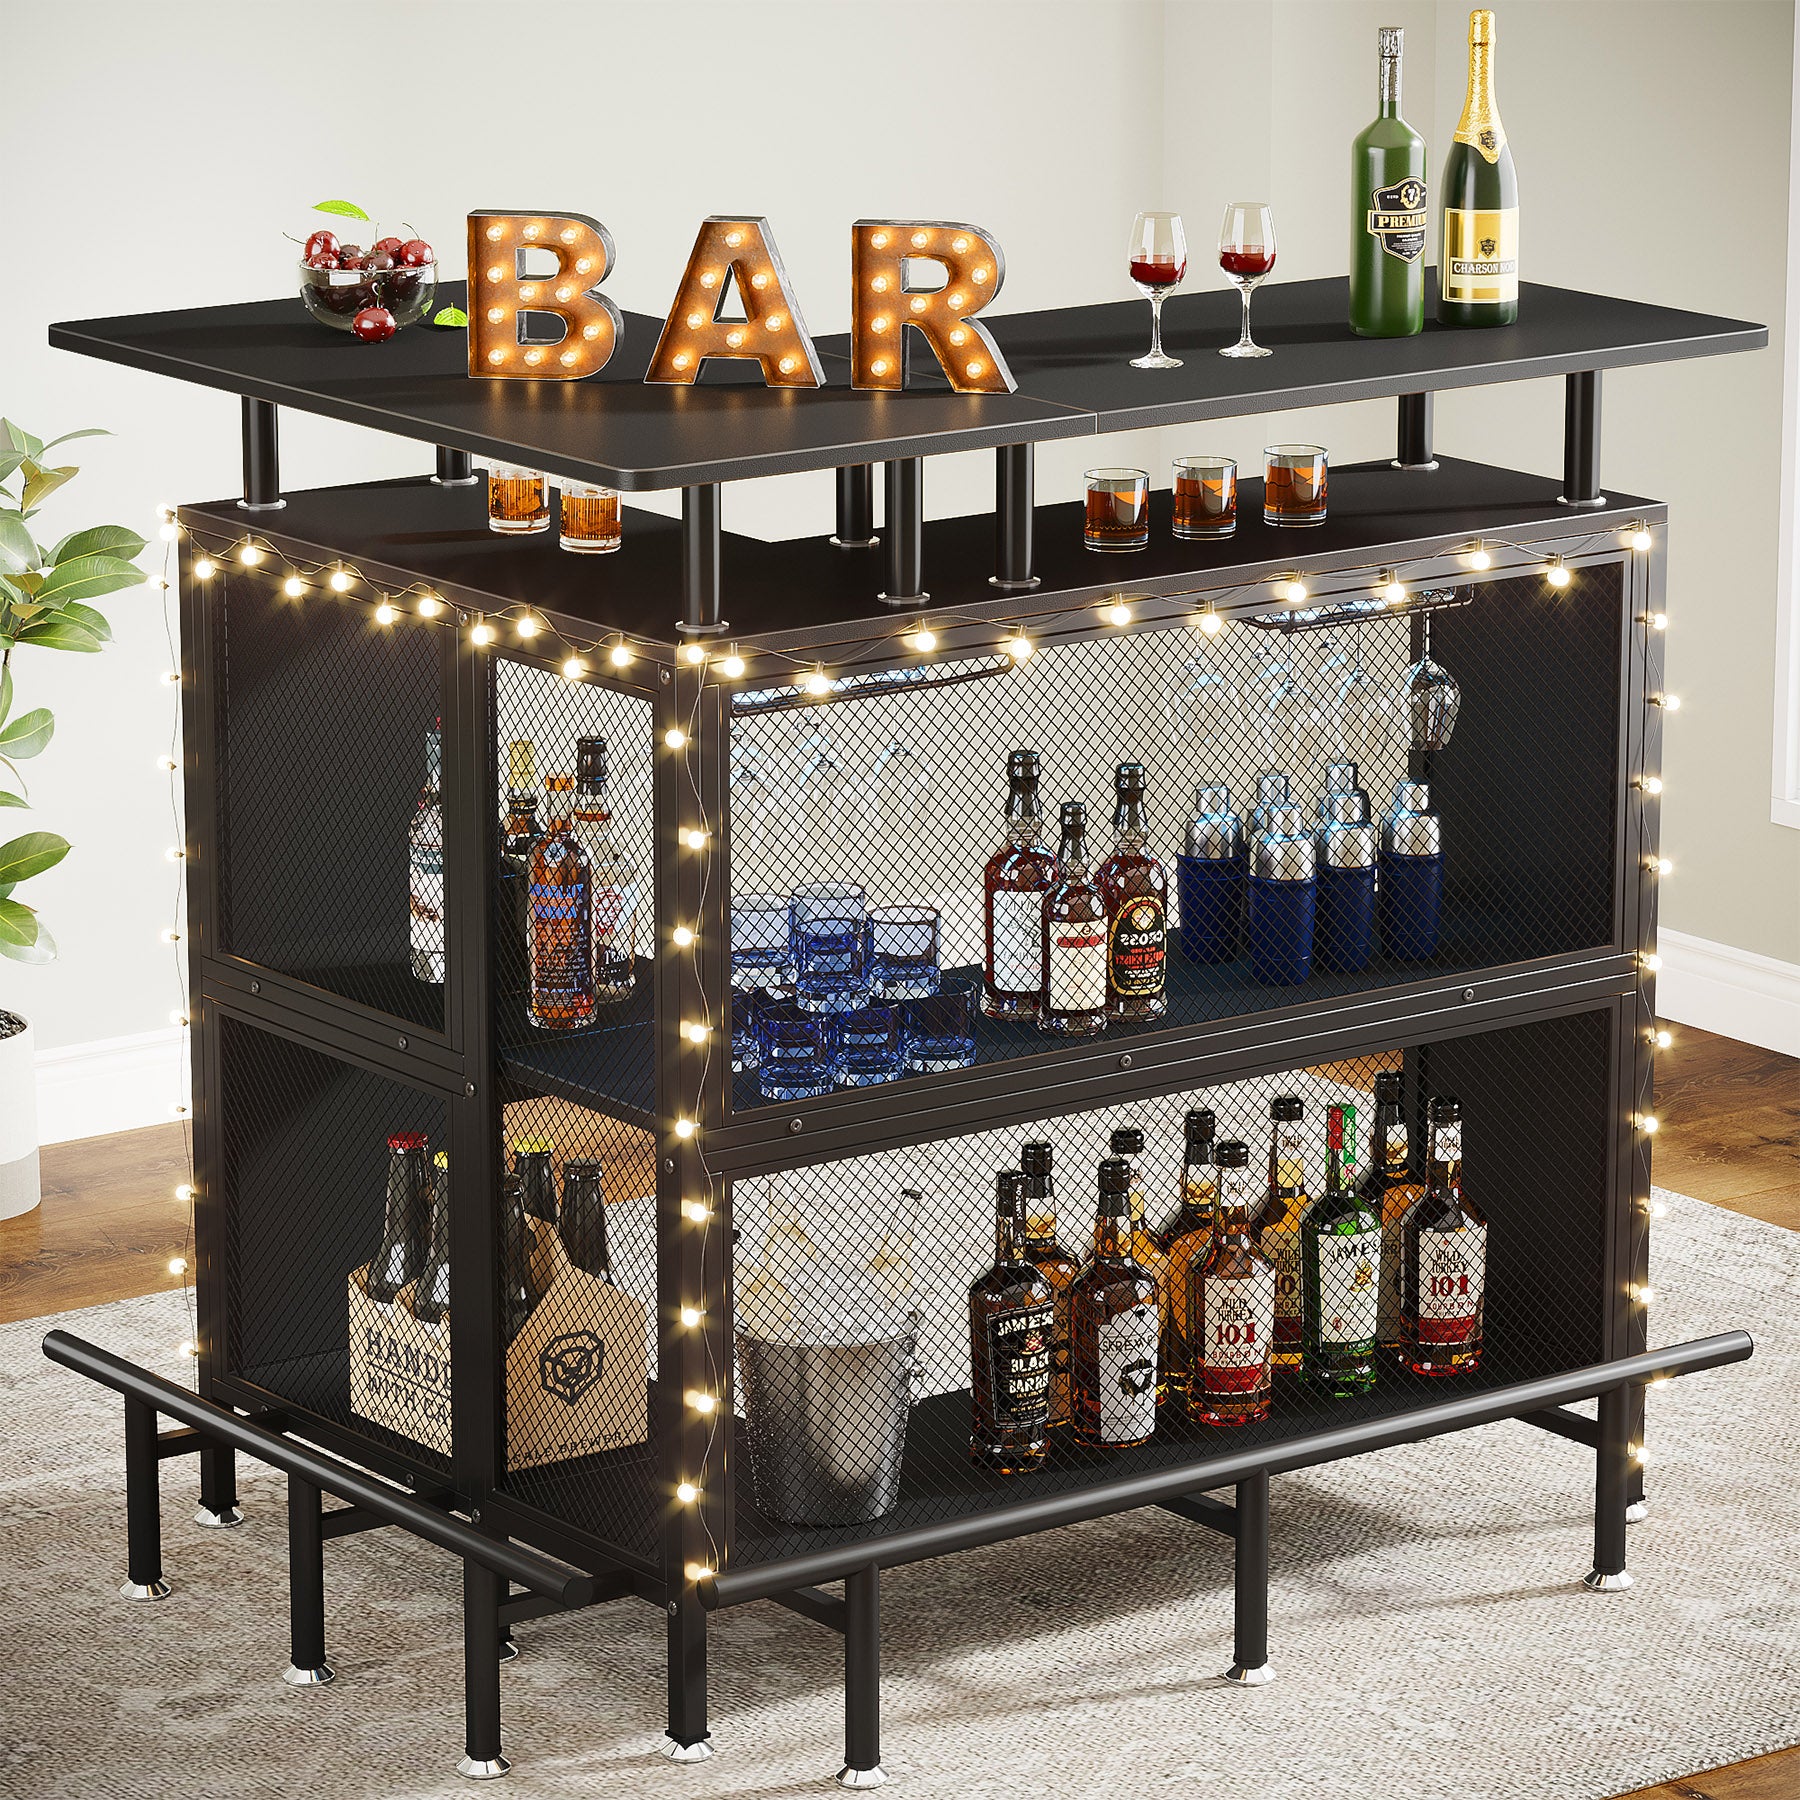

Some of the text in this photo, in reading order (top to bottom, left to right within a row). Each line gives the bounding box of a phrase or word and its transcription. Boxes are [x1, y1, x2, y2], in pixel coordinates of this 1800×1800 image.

[1453, 262, 1499, 275] CHARSON
[467, 209, 1018, 395] BAR
[1430, 1274, 1470, 1297] 101
[1216, 1322, 1256, 1346] 101
